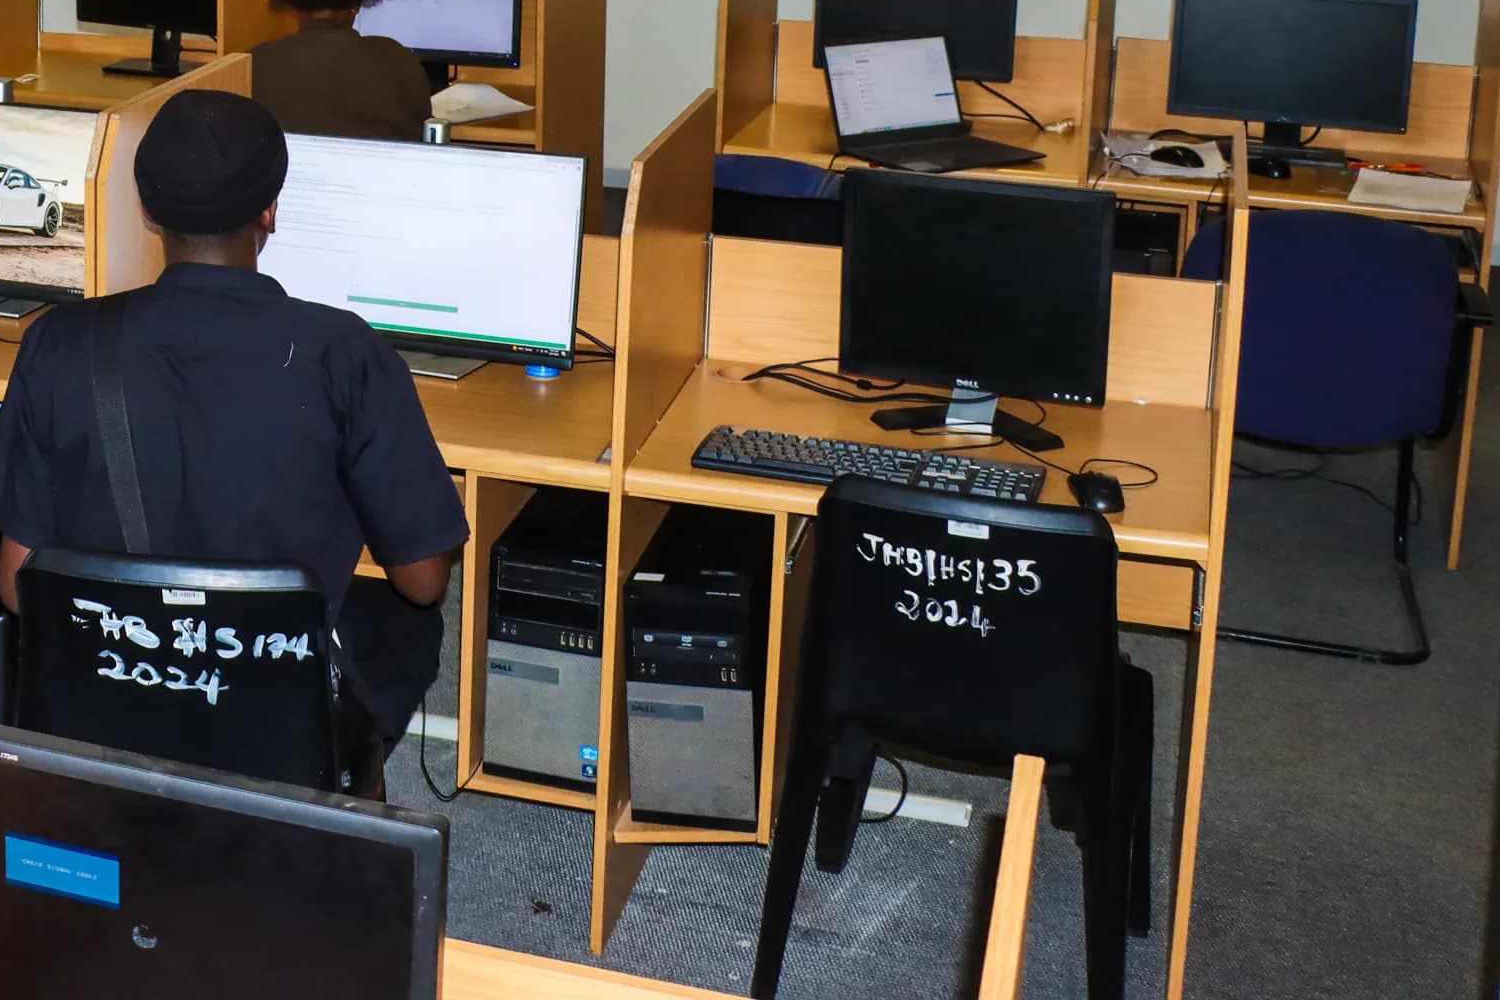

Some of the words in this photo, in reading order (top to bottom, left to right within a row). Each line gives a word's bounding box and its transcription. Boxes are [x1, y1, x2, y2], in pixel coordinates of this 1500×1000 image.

[955, 378, 980, 390] DELL
[895, 590, 996, 638] 2024
[97, 649, 230, 705] 2024
[490, 661, 513, 672] DELL
